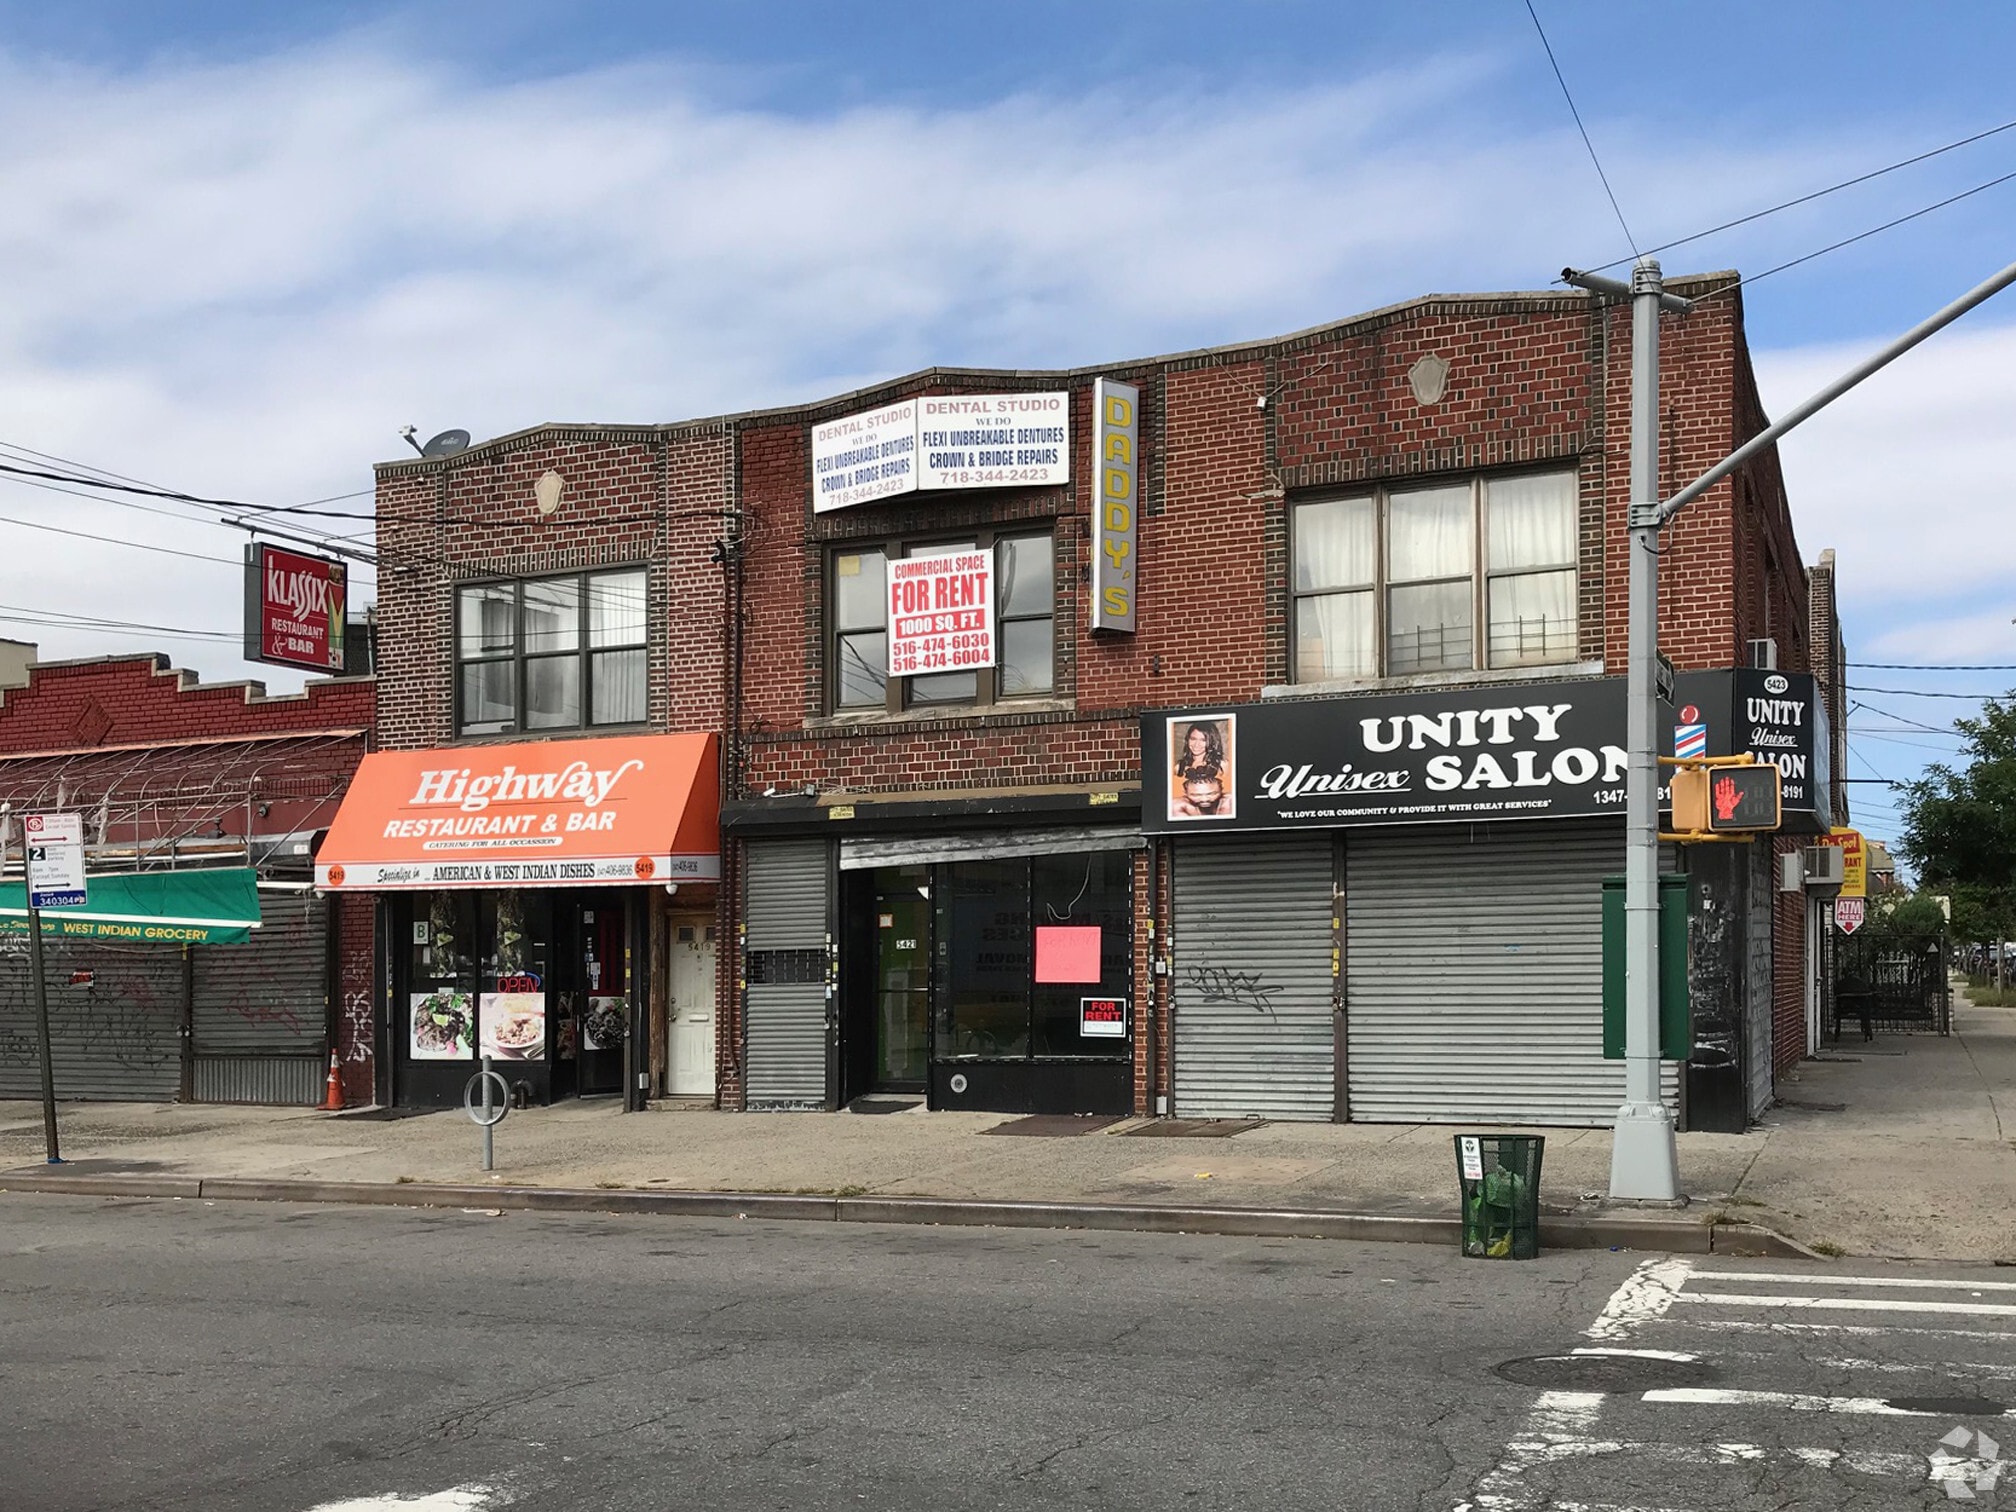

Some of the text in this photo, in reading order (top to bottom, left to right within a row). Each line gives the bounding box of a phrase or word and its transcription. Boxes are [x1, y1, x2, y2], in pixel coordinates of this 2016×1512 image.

[926, 399, 1060, 414] DENTAL STUDIO
[819, 407, 912, 441] DENTAL STUDIO
[976, 417, 1011, 426] WE DO
[852, 433, 877, 445] WE DO
[923, 427, 1064, 447] FLEXI UNBREAKABLE DENTURES
[817, 435, 914, 474] FLEXI UNBREAKABLE DENTURES
[930, 449, 1058, 469] CROWN & BRIDGE REPAIRS
[821, 457, 910, 493] CROWN & BRIDGE REPAIRS
[940, 468, 1048, 484] 718-344-2423
[830, 478, 904, 505] 718-344-2423
[1103, 394, 1132, 617] DADDY'S
[895, 554, 984, 579] COMMERCIAL SPACE
[268, 555, 328, 622] KLASSIX
[892, 572, 988, 615] FOR RENT
[272, 618, 324, 640] RESTAURANT
[899, 611, 980, 636] 1000 SQ. FT.
[272, 633, 314, 655] & BAR
[893, 632, 989, 656] 516-474-6030
[893, 648, 990, 672] 516-474-6004
[1767, 680, 1786, 690] 5423
[1746, 698, 1805, 726] UNITY
[1359, 704, 1572, 753] UNITY
[1751, 727, 1796, 746] Unisex
[409, 759, 645, 812] Highway
[1259, 763, 1411, 799] Unisex
[1295, 809, 1316, 818] LOVE
[1317, 809, 1335, 817] OUR
[1337, 807, 1387, 817] COMMUNITY
[1398, 805, 1436, 814] PROVIDE
[1437, 804, 1446, 813] IT
[1448, 803, 1472, 812] WITH
[1472, 802, 1503, 811] GREAT
[383, 812, 617, 838] RESTAURANT & BAR
[429, 841, 470, 849] CATERING
[491, 839, 508, 847] ALL
[509, 838, 557, 846] OCCASSION
[32, 848, 42, 860] 2
[329, 870, 345, 881] 5419
[433, 865, 482, 881] AMERICAN
[484, 865, 490, 880] &
[494, 865, 520, 880] WEST
[522, 864, 559, 879] INDIAN
[560, 863, 595, 878] DISHES
[636, 863, 653, 873] 5419
[40, 896, 73, 906] 340304
[1838, 901, 1860, 914] ATM
[63, 922, 94, 935] WEST
[97, 924, 141, 937] INDIAN
[145, 927, 209, 940] GROCERY
[417, 925, 425, 938] B
[688, 942, 711, 952] 5419
[497, 978, 538, 993] OPEN
[1085, 1011, 1121, 1021] RENT
[1091, 1001, 1116, 1011] FOR
